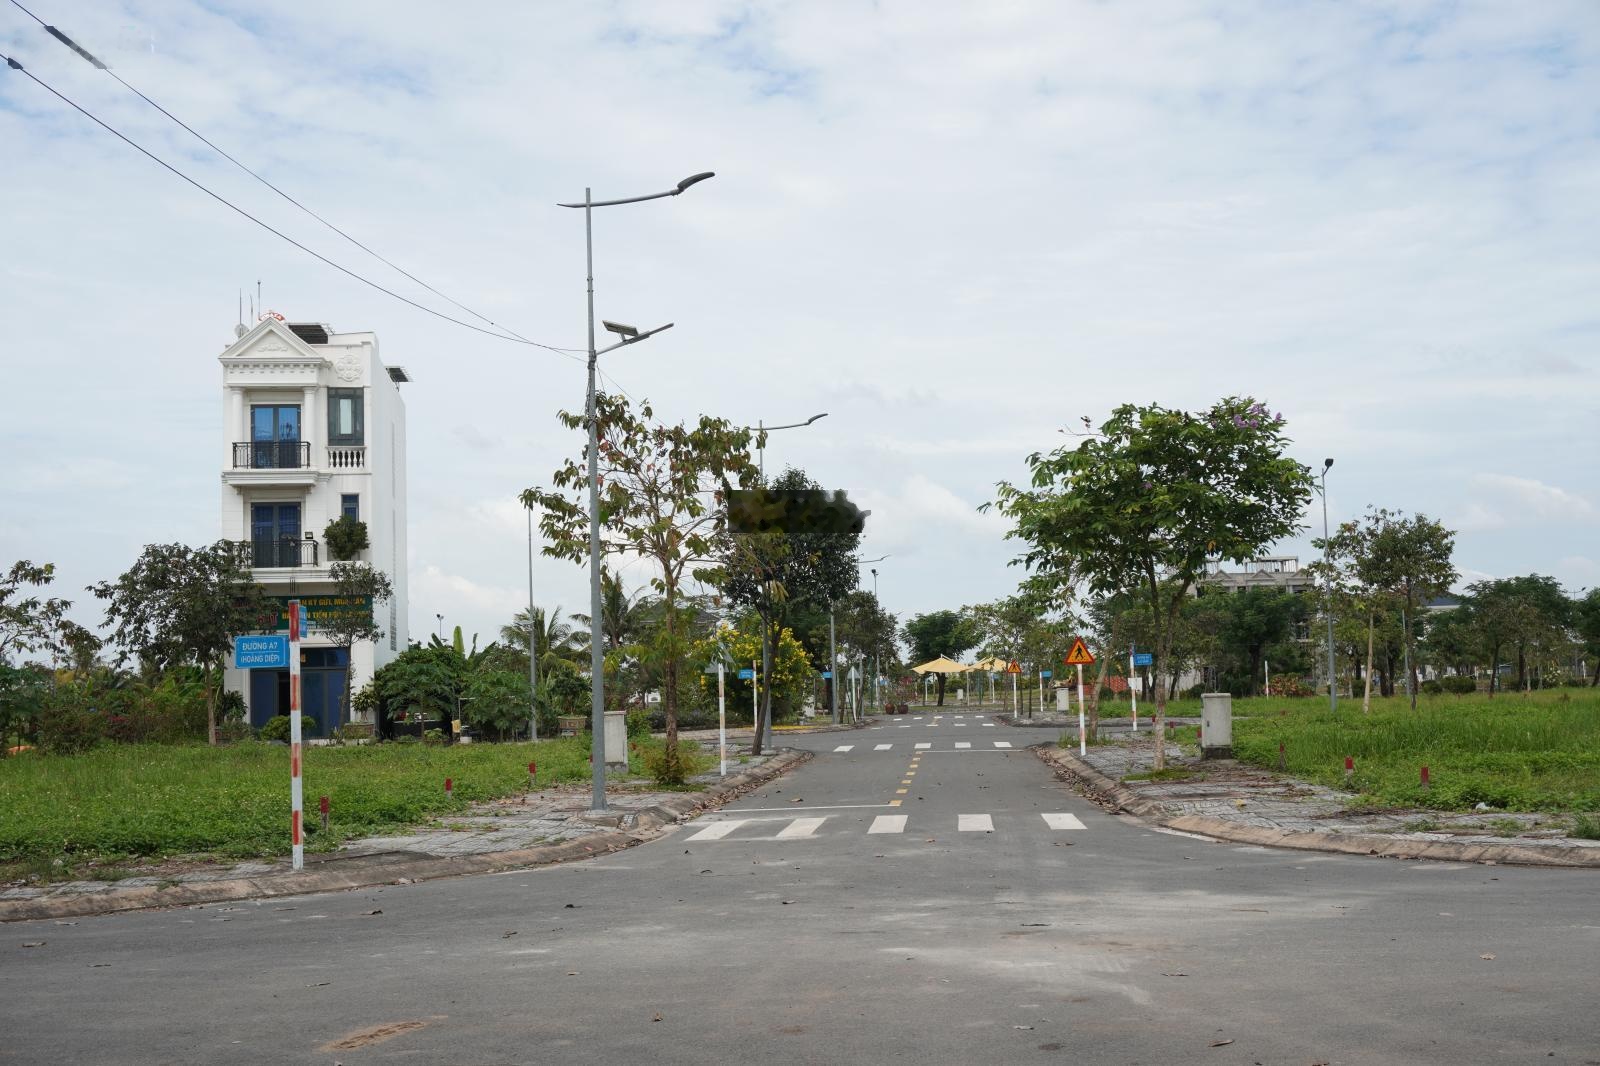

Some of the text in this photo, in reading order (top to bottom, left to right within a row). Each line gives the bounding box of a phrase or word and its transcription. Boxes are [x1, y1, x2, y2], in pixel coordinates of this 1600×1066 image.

[242, 640, 278, 650] ĐƯỜNG A7
[240, 654, 263, 664] (HOÀNG
